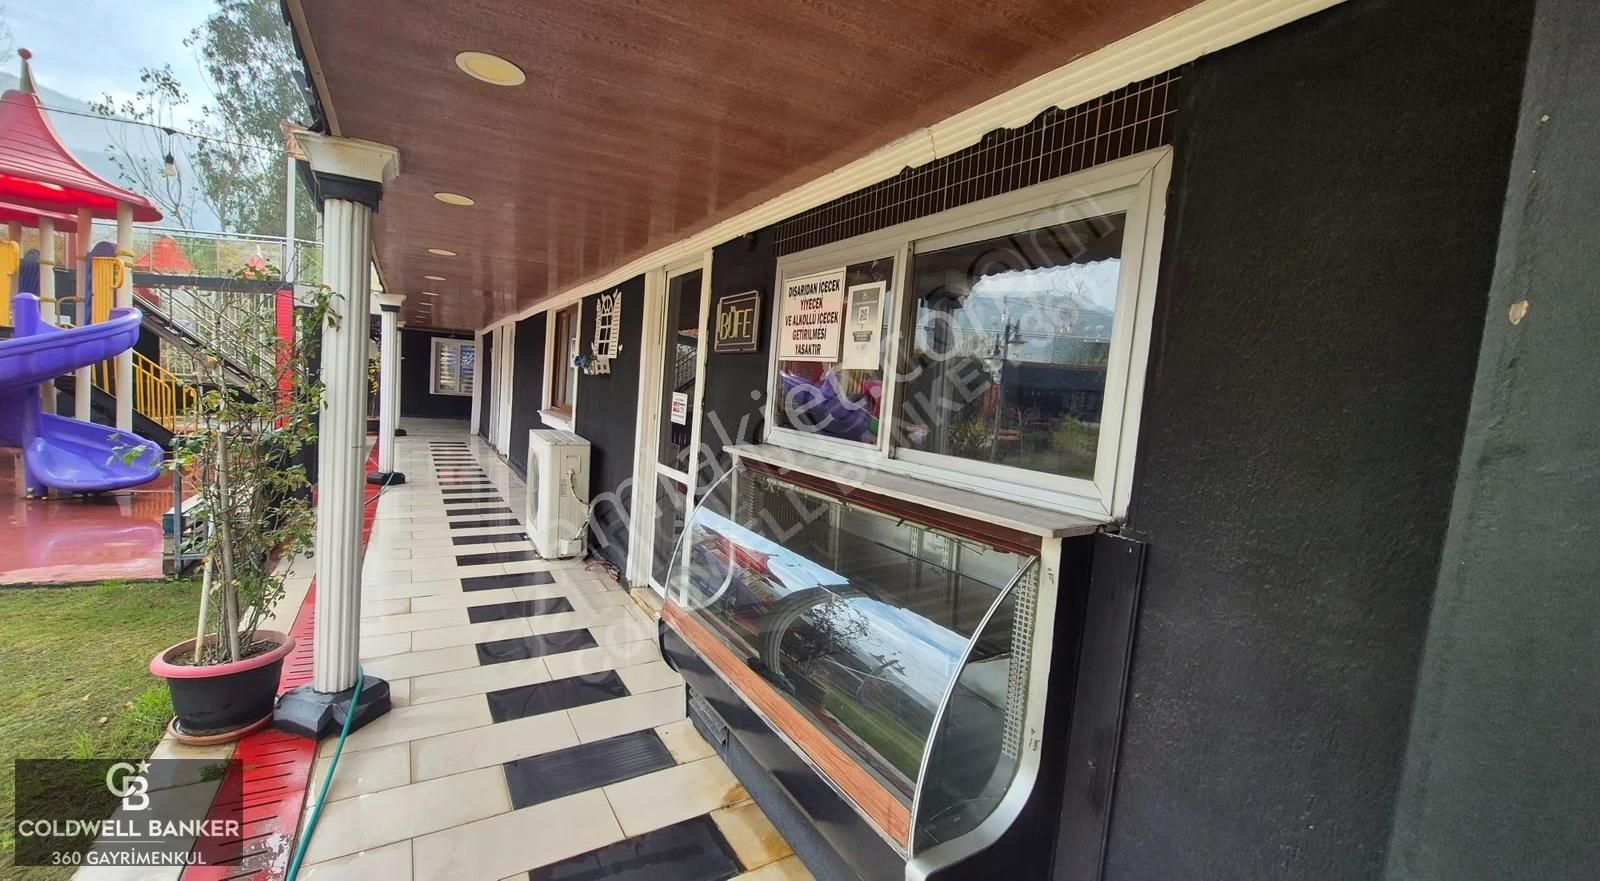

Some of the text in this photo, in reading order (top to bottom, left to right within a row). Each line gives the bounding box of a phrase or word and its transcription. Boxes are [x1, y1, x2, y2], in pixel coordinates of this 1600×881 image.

[788, 279, 840, 300] DIŞARIDAN İÇECEK
[800, 296, 824, 311] YİYECEK
[719, 305, 753, 341] BÜFE
[785, 310, 839, 328] VE ALKOLLÜ İÇECEK
[792, 326, 827, 341] GETİRİLMESİ
[795, 343, 821, 356] YASAKTIR
